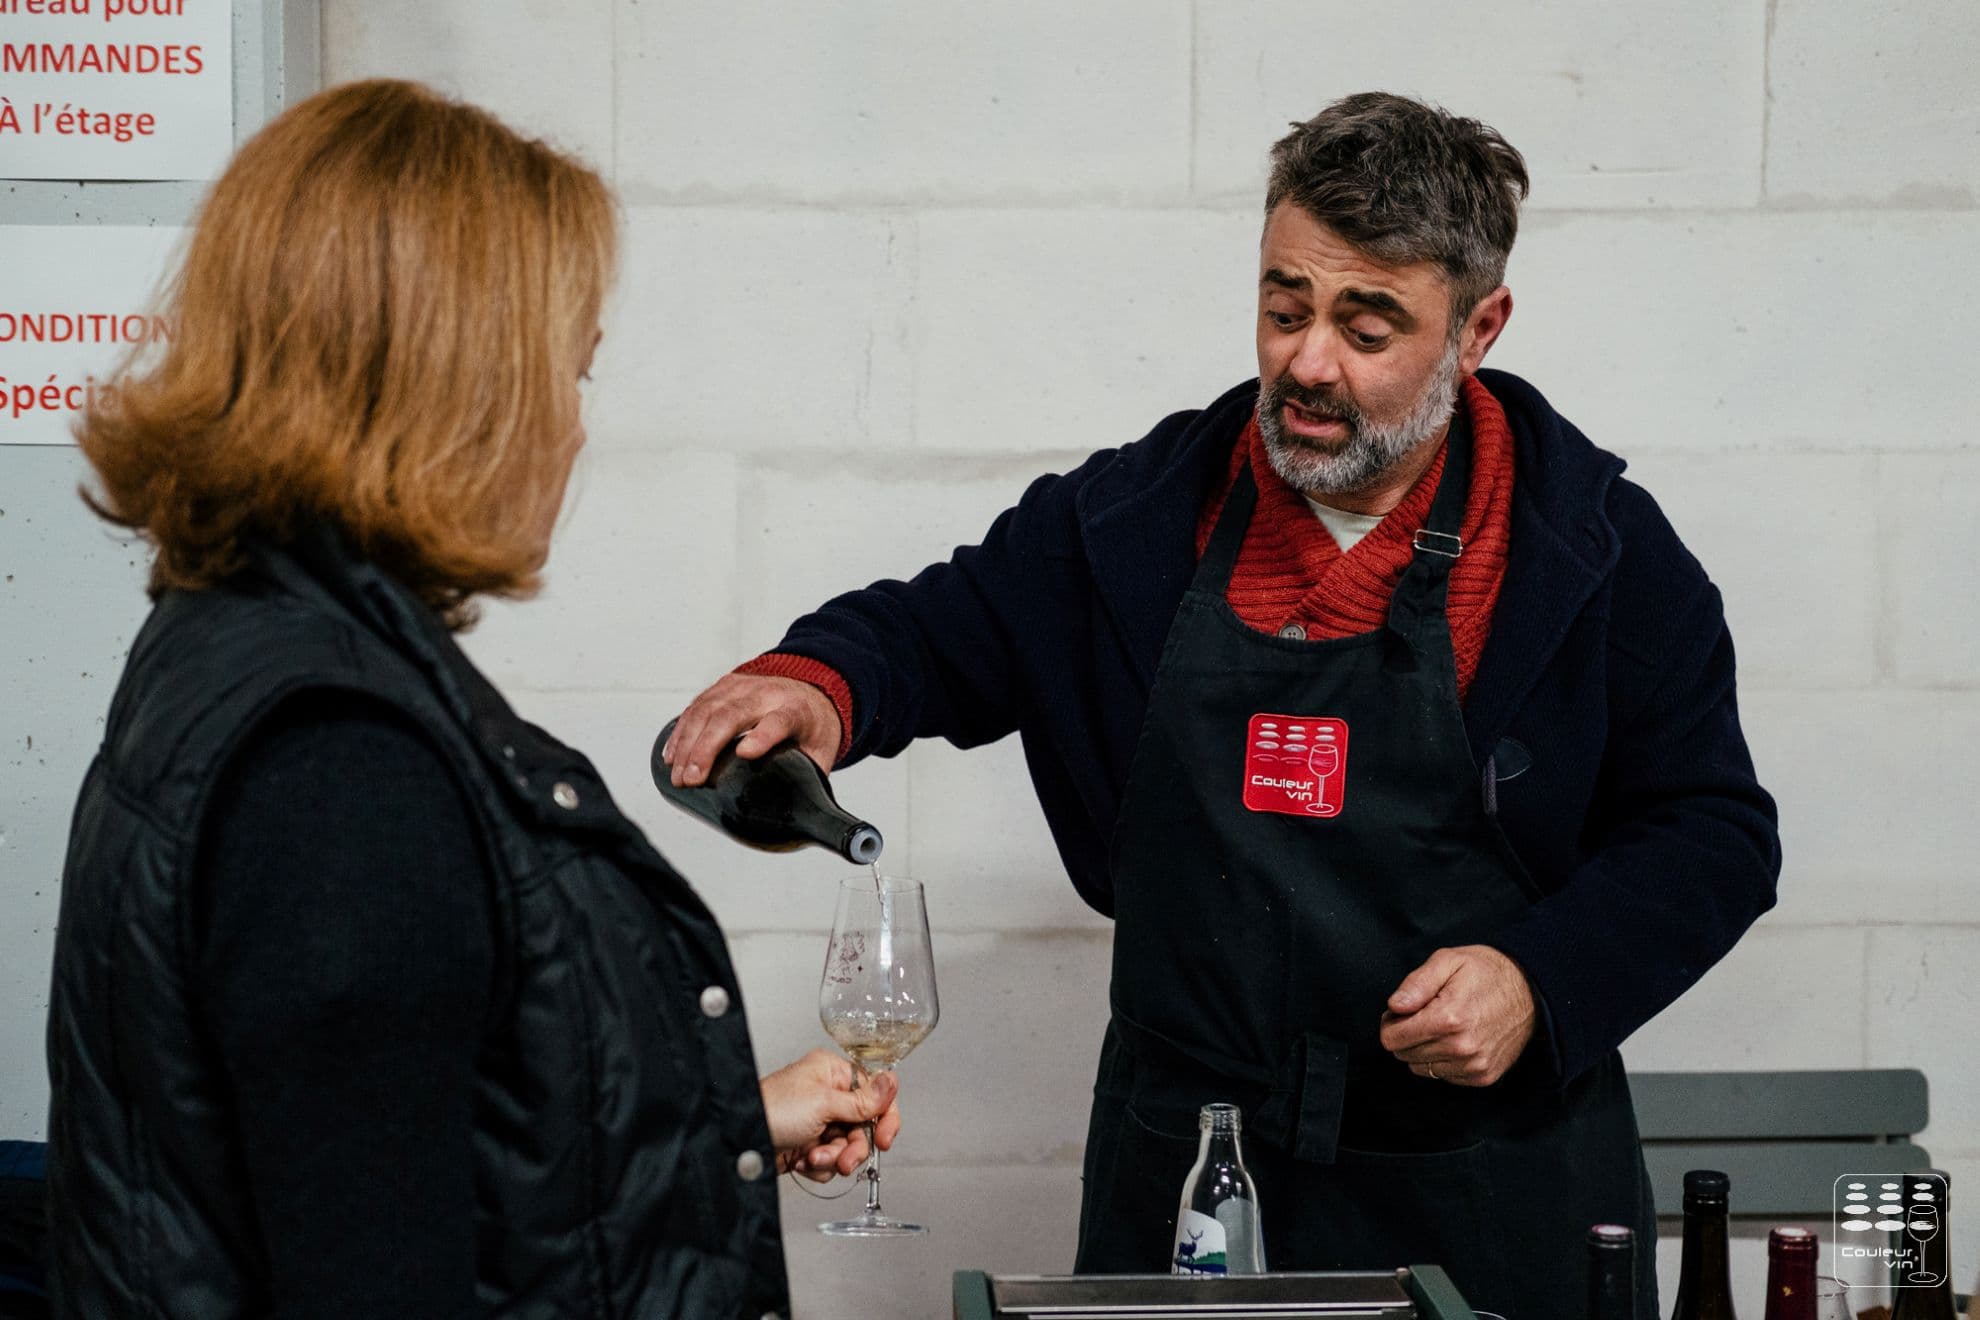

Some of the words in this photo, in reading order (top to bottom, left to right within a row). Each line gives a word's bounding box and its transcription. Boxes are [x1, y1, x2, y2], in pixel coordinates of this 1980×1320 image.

[104, 0, 185, 22] pour
[3, 43, 204, 75] MMANDES
[0, 96, 22, 135] À
[33, 103, 156, 143] l’étage
[1251, 774, 1314, 791] Couleur
[1285, 790, 1313, 801] vin
